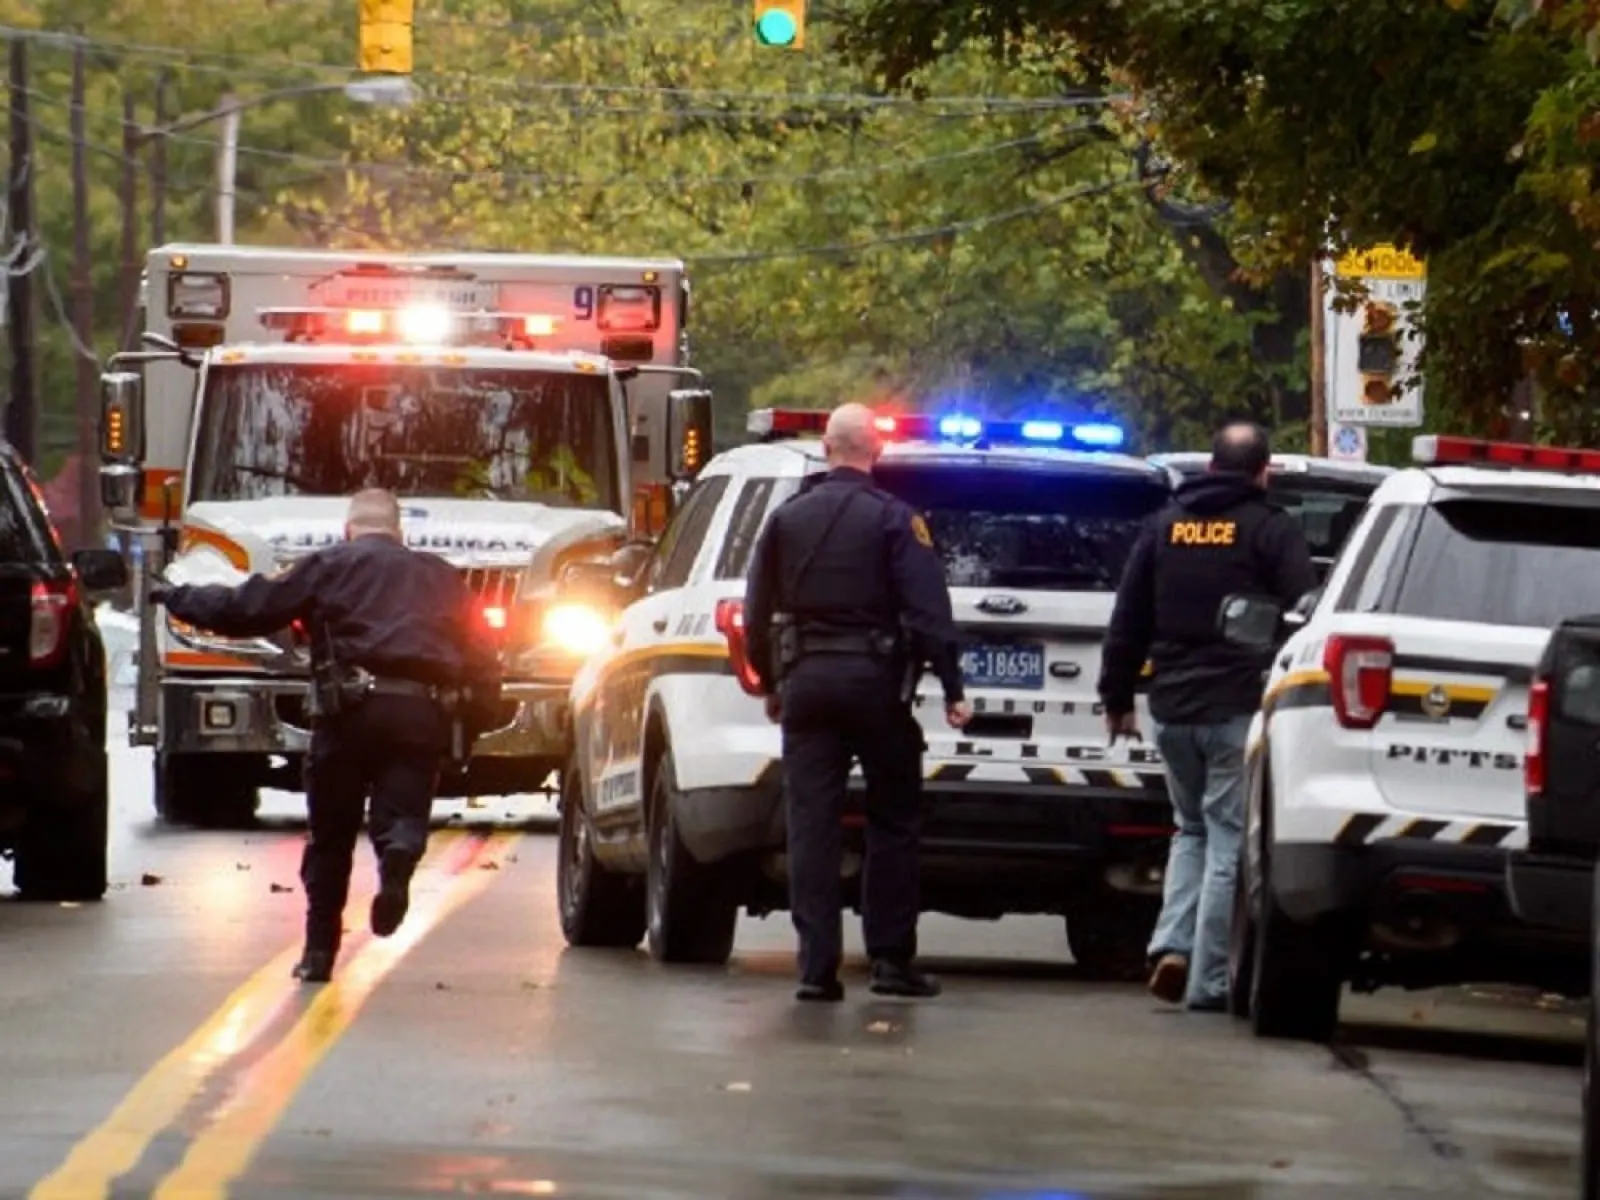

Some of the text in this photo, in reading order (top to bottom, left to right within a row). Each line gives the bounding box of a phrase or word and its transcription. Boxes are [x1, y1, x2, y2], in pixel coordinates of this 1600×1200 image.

[574, 285, 593, 320] 9
[1171, 522, 1236, 544] POLICE
[1386, 744, 1518, 769] PITTS
